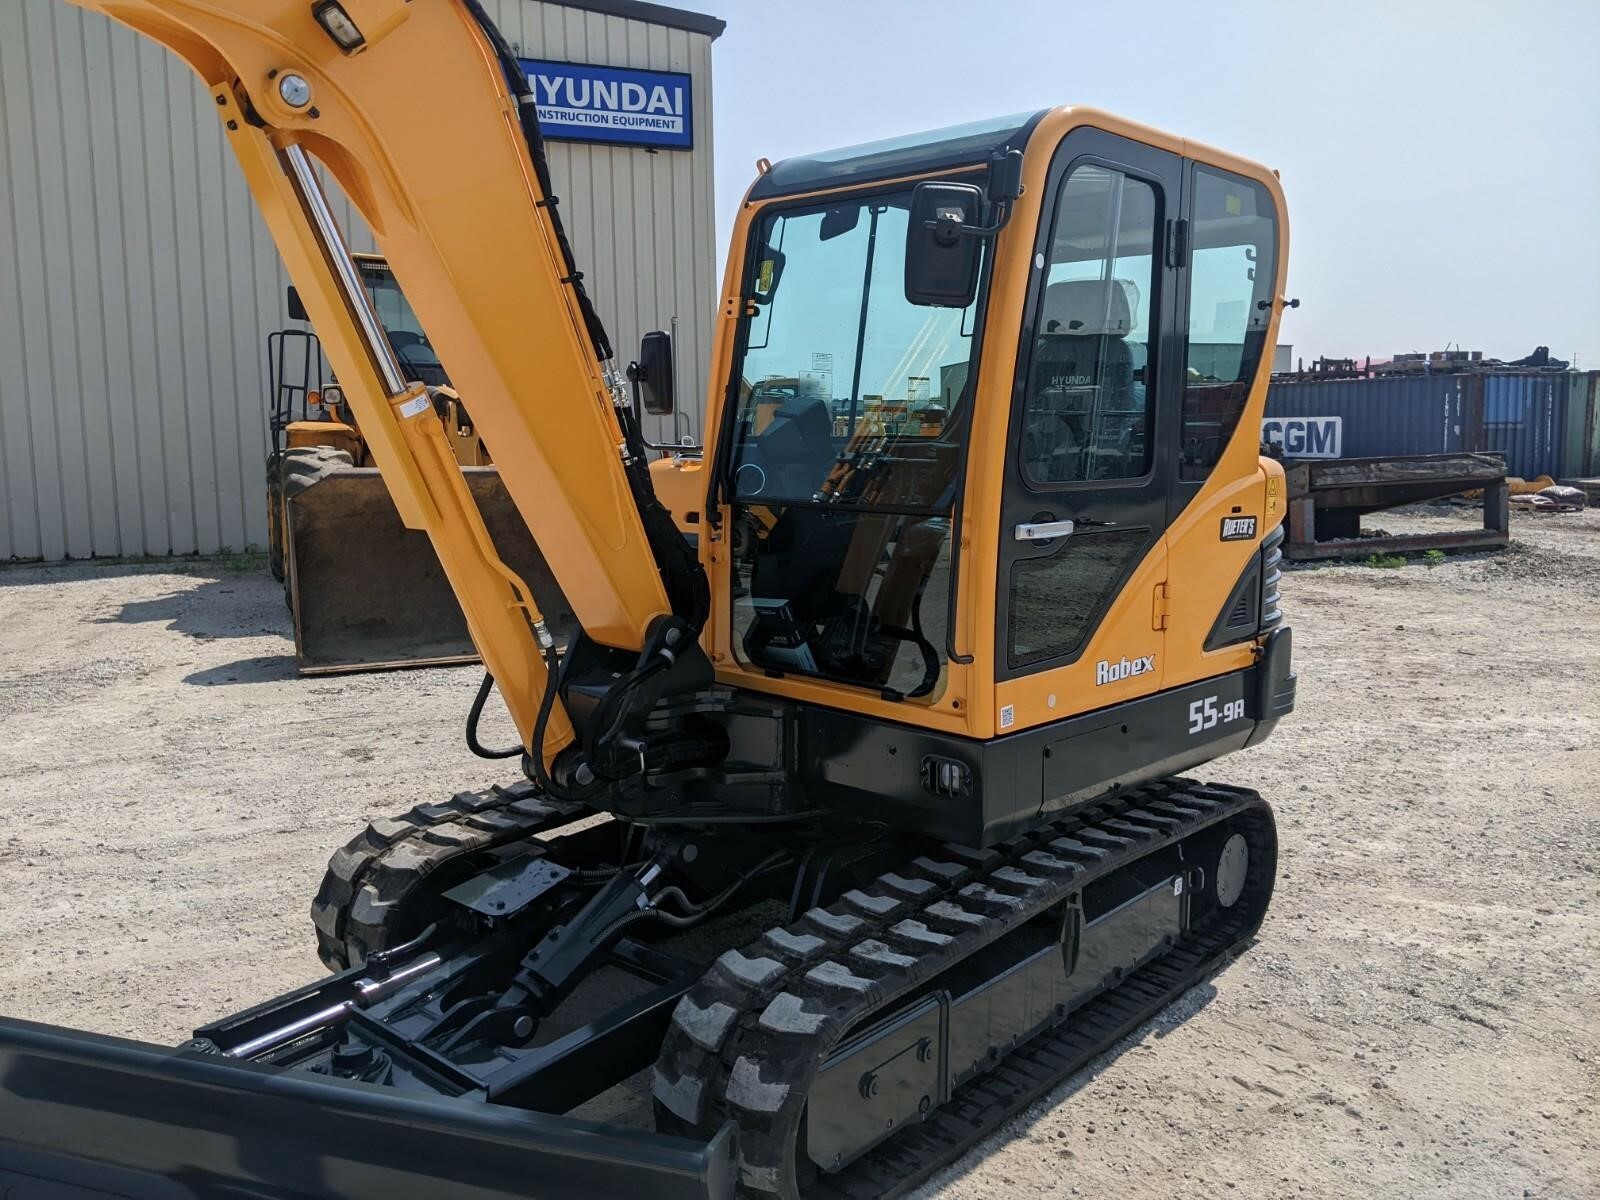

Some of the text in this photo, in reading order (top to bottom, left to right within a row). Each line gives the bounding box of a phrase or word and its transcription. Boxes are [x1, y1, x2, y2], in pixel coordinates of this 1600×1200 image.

[538, 109, 677, 129] NSTRUCTION EQUIPMENT
[1264, 421, 1337, 453] CGM
[1096, 653, 1156, 686] Robex
[1188, 695, 1245, 735] 55-9A
